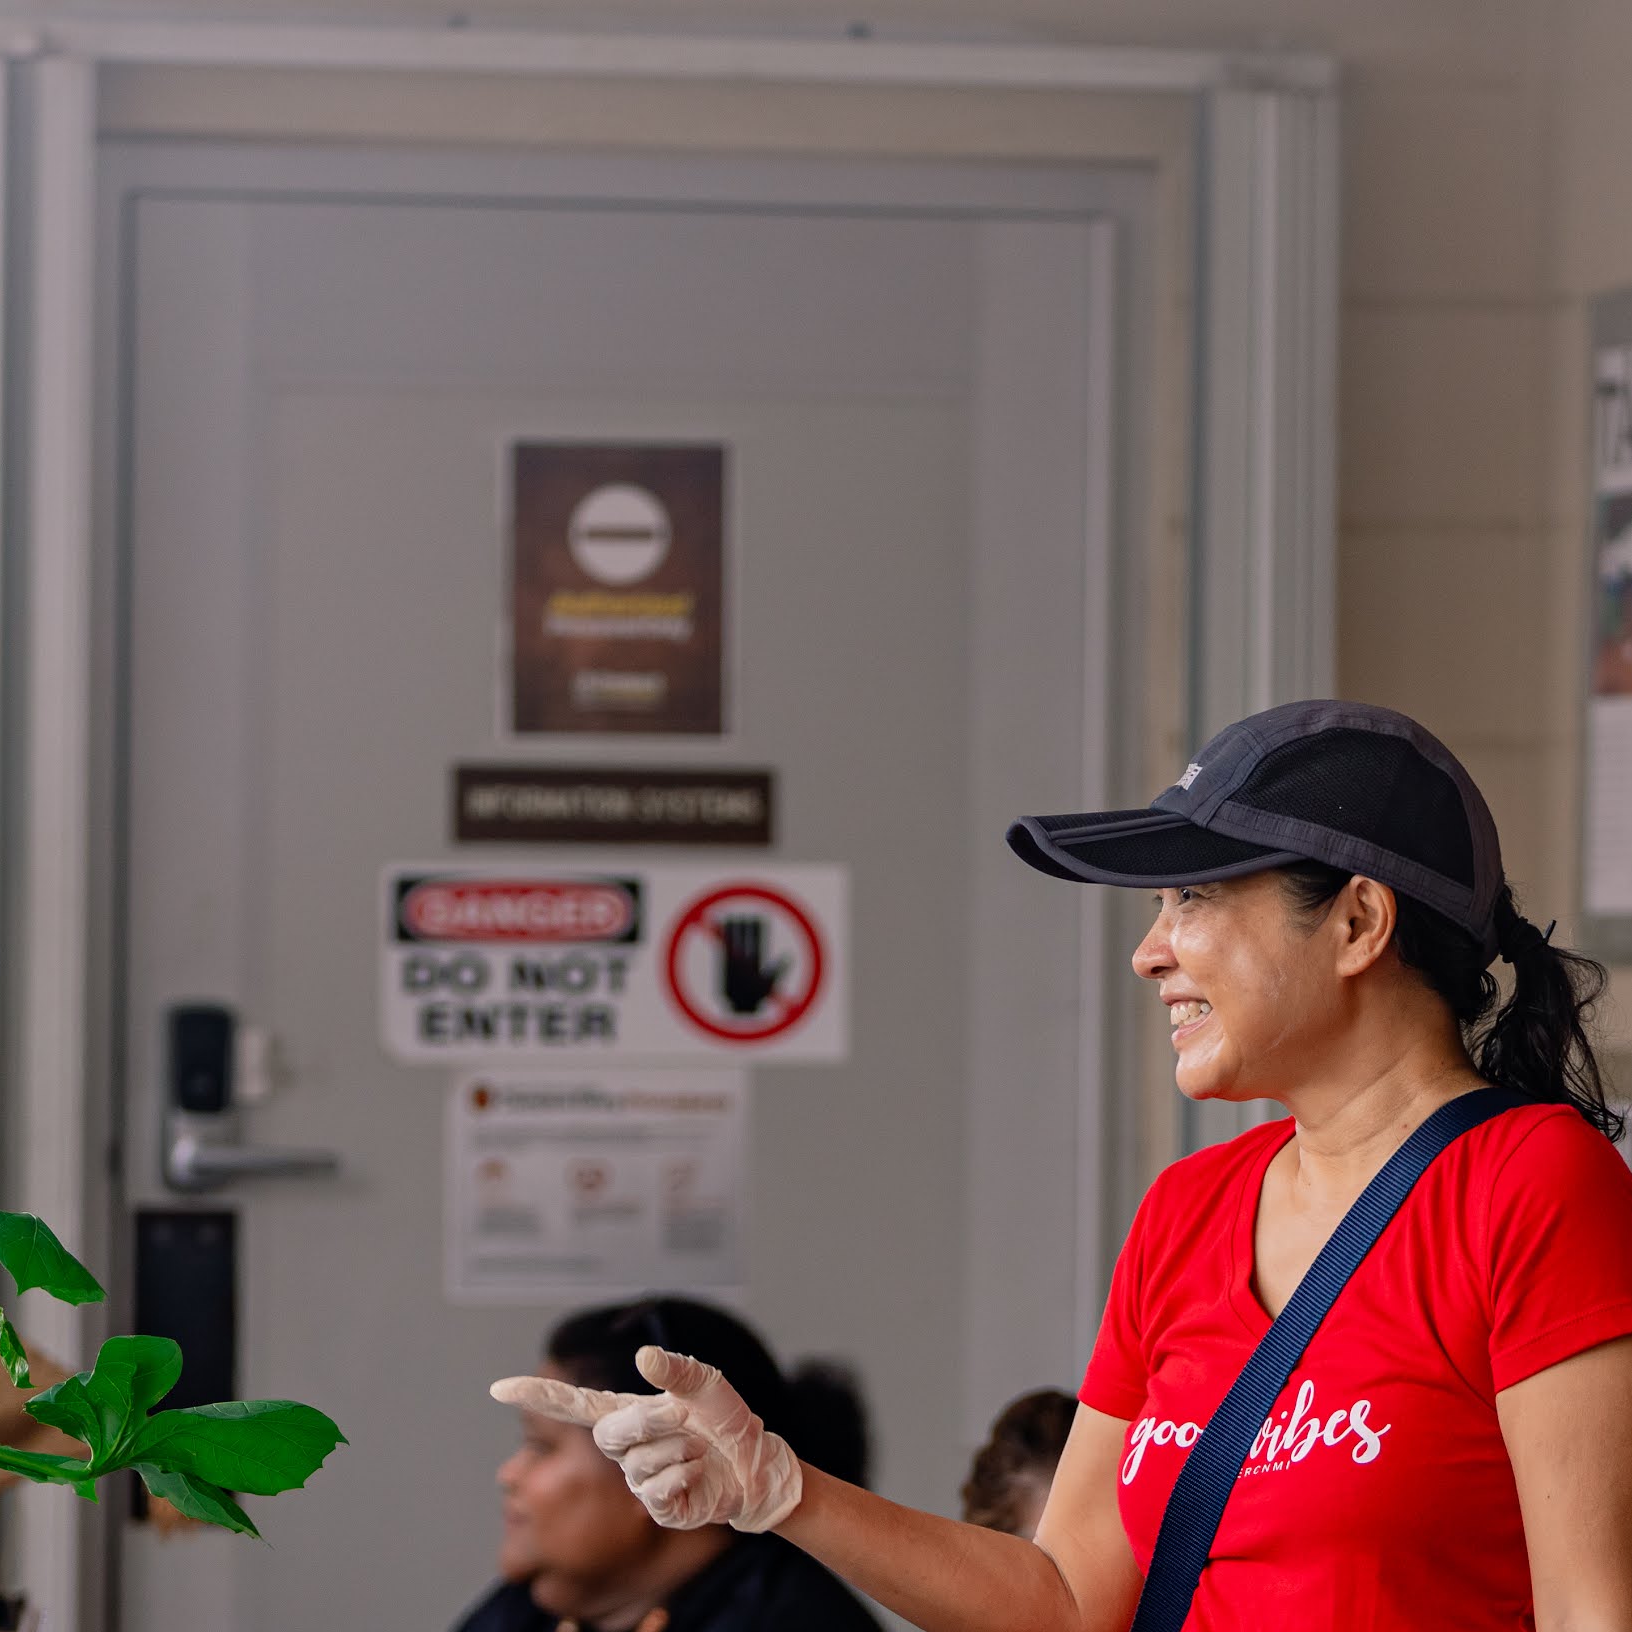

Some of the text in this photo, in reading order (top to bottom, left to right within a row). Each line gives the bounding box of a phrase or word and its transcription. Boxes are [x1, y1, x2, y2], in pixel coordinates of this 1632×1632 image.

[421, 897, 612, 928] DANGER
[401, 952, 628, 994] DO NOT
[419, 1002, 619, 1044] ENTER
[1122, 1416, 1204, 1486] goo
